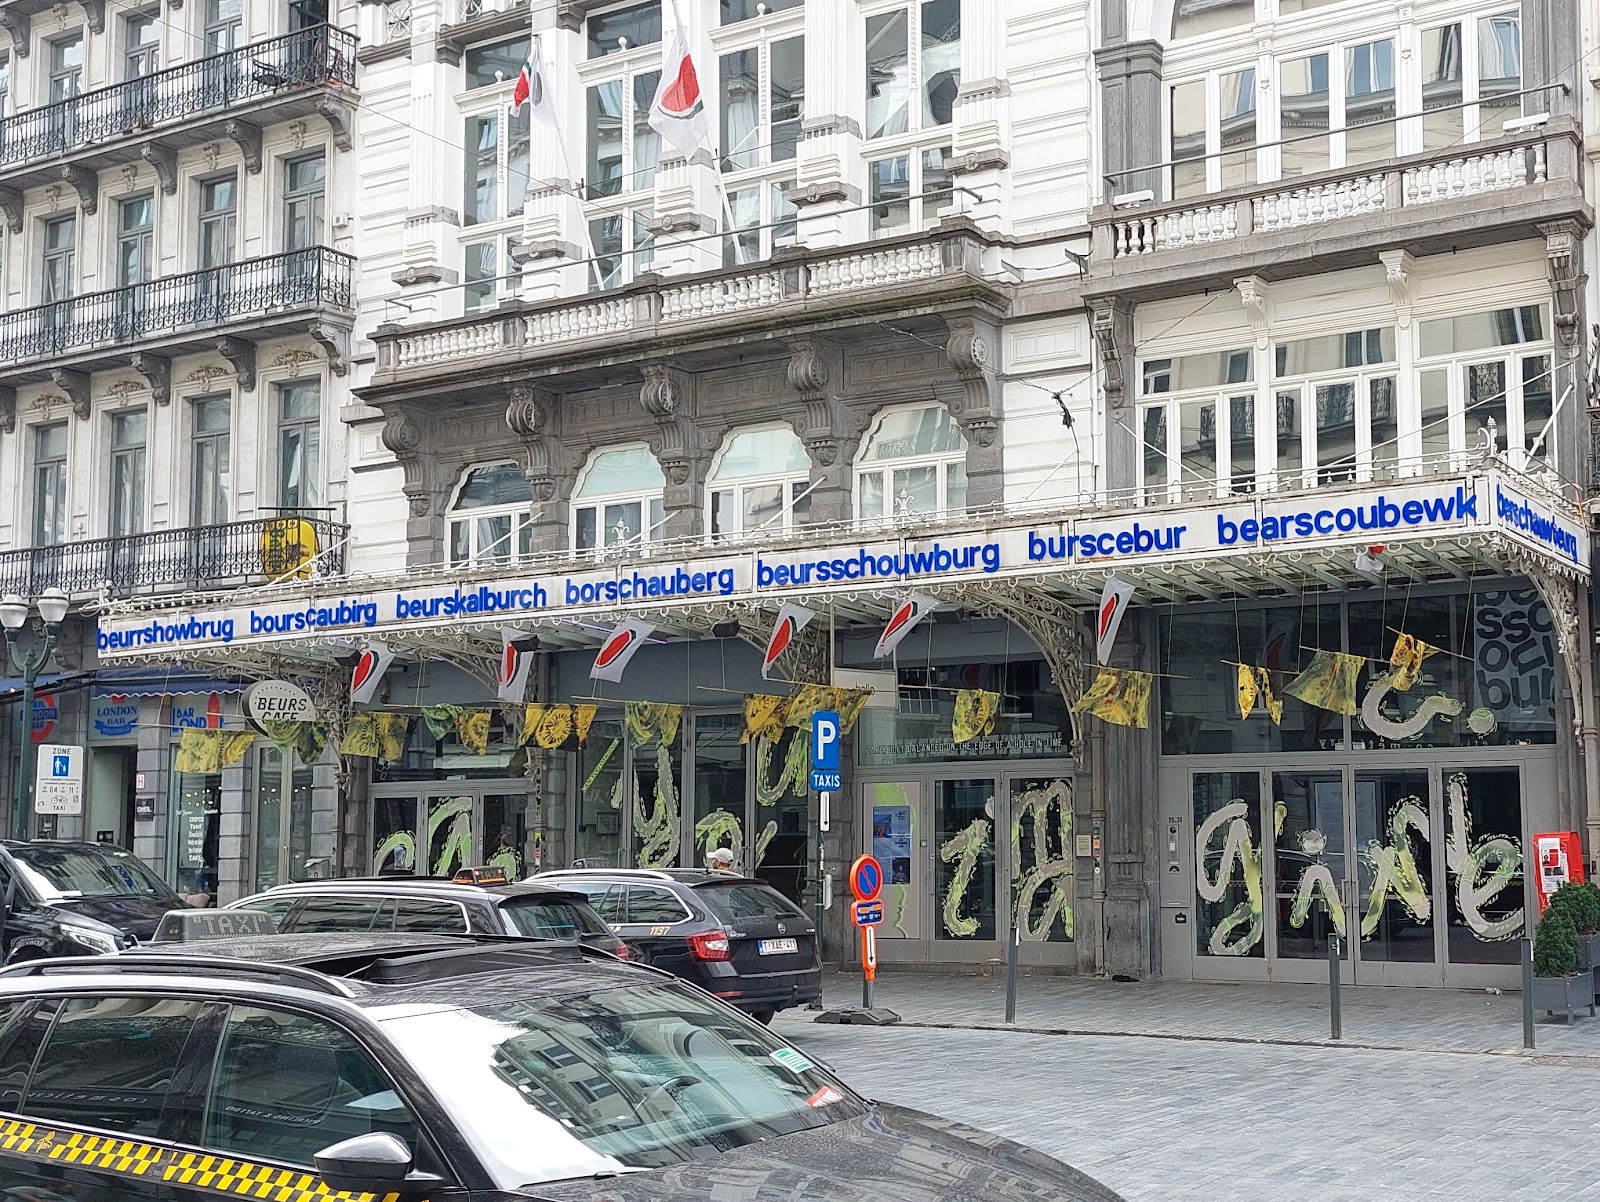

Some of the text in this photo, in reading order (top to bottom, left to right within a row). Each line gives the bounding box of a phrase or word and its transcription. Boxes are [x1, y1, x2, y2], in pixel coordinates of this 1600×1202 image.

[96, 487, 1478, 650] beurrshowbrug bourscaubirg beurskalburch borschauberg beursschouwburg burscebur bearscoubewk
[97, 705, 138, 717] LONDON
[257, 697, 308, 711] BEURS
[817, 720, 837, 760] P
[959, 741, 971, 751] THE
[974, 740, 992, 750] EDGE
[995, 740, 1004, 749] OF
[1014, 739, 1032, 749] HOLE
[1035, 739, 1042, 748] IN
[1045, 738, 1063, 747] TIME
[813, 774, 841, 788] TAXIS
